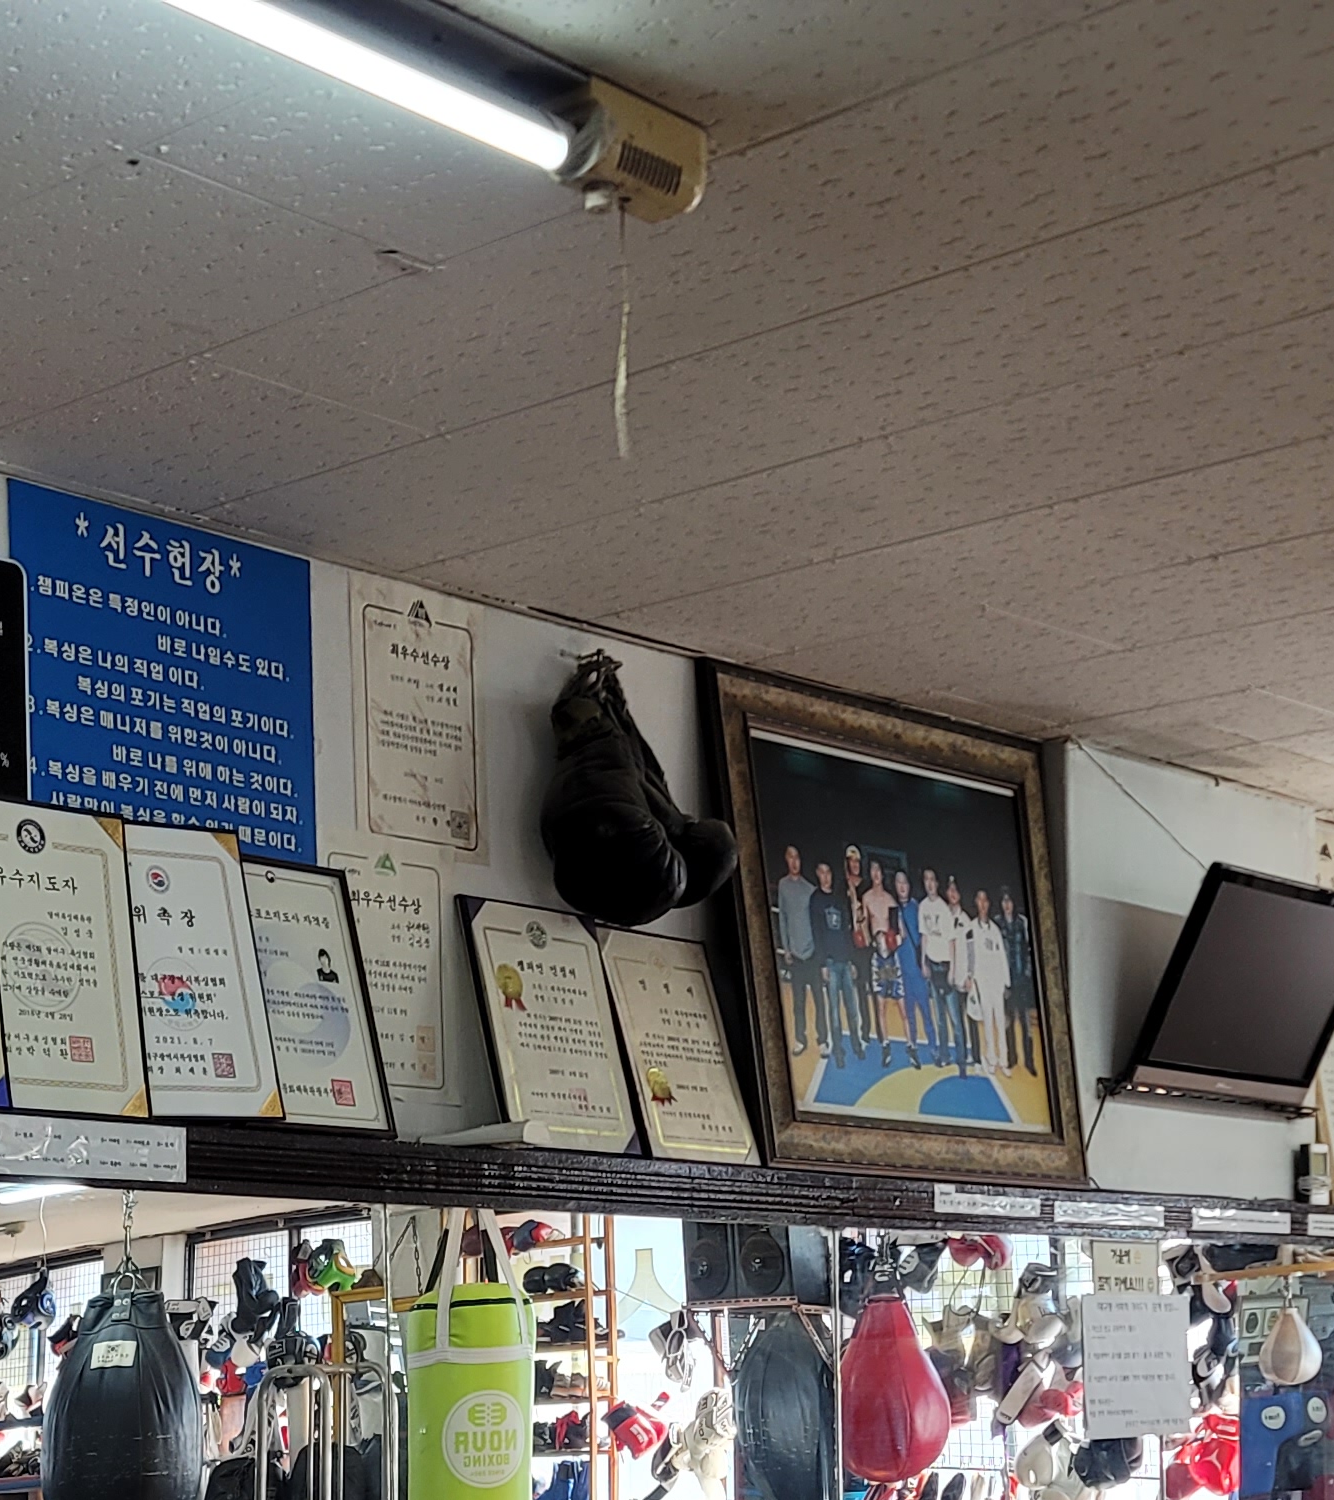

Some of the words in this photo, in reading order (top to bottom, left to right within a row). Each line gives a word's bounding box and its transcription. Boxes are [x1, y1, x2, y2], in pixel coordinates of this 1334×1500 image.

[108, 593, 171, 625] 특정인이
[175, 610, 228, 638] 아니다.
[98, 650, 129, 673] 나의
[134, 658, 164, 682] 직업
[168, 667, 205, 691] 이다.
[157, 634, 188, 657] 바로
[256, 658, 291, 682] 있다.
[77, 675, 126, 703] 복싱의
[130, 687, 177, 713] 포기는
[181, 698, 226, 724] 직업의
[230, 708, 295, 739] 포기이다.
[99, 709, 164, 740] 매니저를
[168, 725, 229, 753] 위한것이
[233, 739, 283, 766] 아니다.
[113, 744, 144, 768] 바로
[148, 751, 178, 774] 나를
[183, 759, 213, 781] 위해
[217, 765, 246, 788] 하는
[250, 771, 299, 798] 것이다.
[102, 770, 150, 796] 배우기
[154, 780, 184, 802] 전에
[189, 786, 218, 809] 먼저
[222, 793, 266, 818] 사람이
[270, 803, 304, 825] 되자.
[238, 825, 303, 854] 때문이다.
